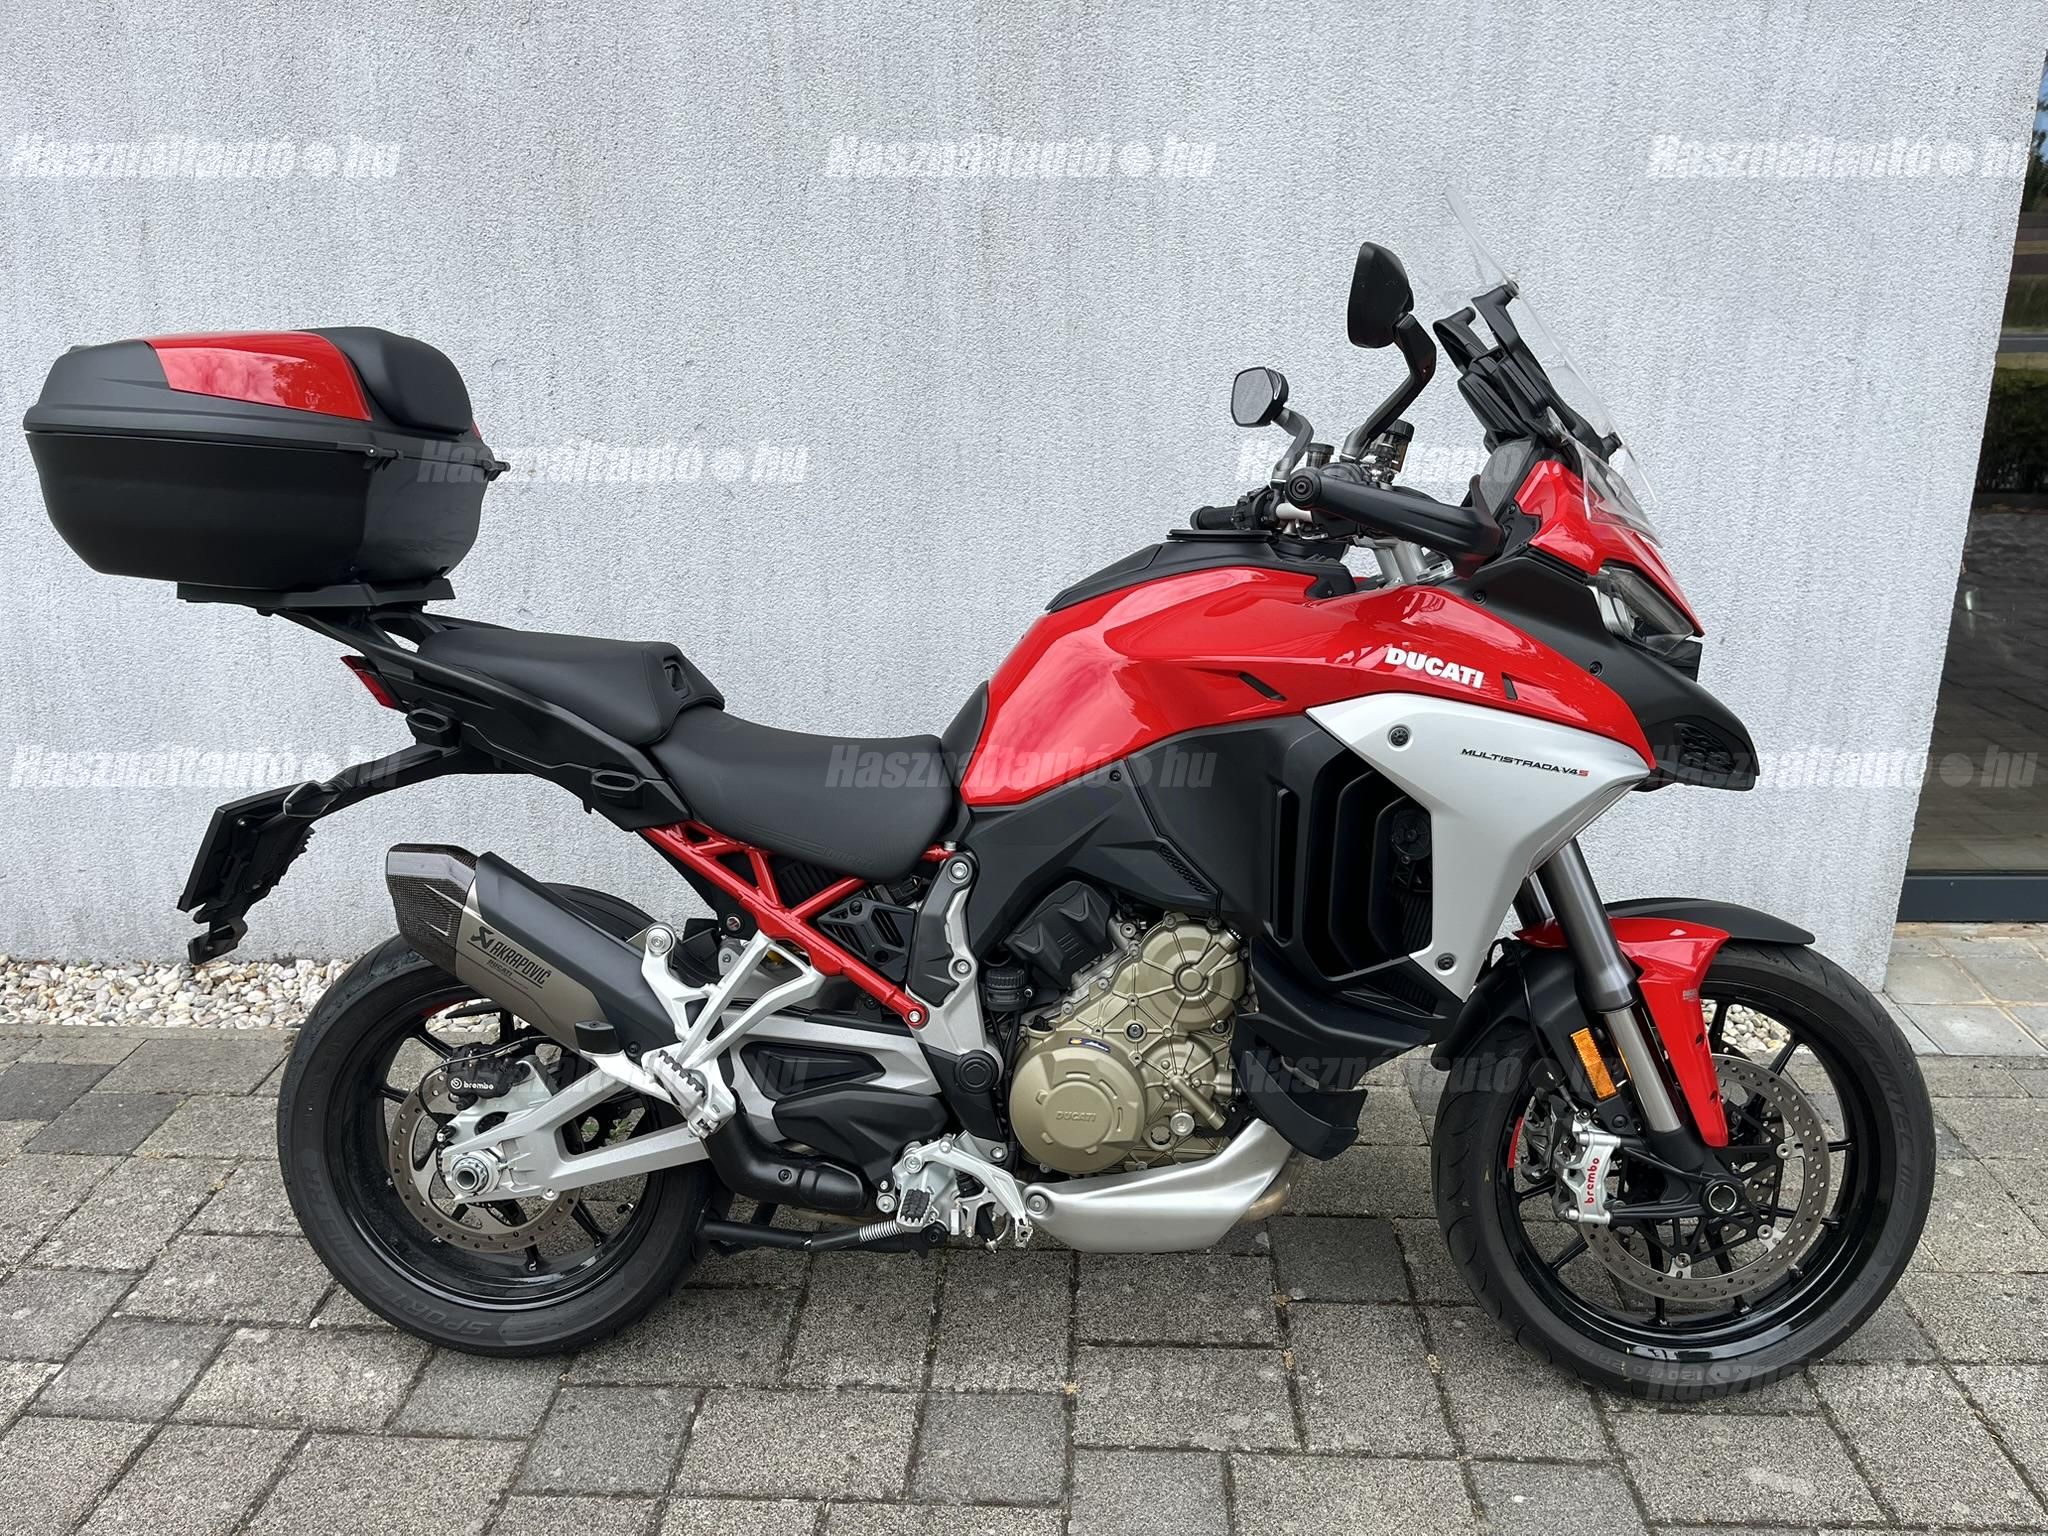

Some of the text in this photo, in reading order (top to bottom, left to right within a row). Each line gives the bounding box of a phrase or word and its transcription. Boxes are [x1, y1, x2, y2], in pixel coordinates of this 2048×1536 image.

[1384, 647, 1485, 689] DUCATI
[1461, 748, 1590, 777] MULTISTRADA V4S
[463, 1080, 494, 1090] brembo
[1056, 1110, 1097, 1122] DUCATI
[1584, 1157, 1600, 1204] brembo
